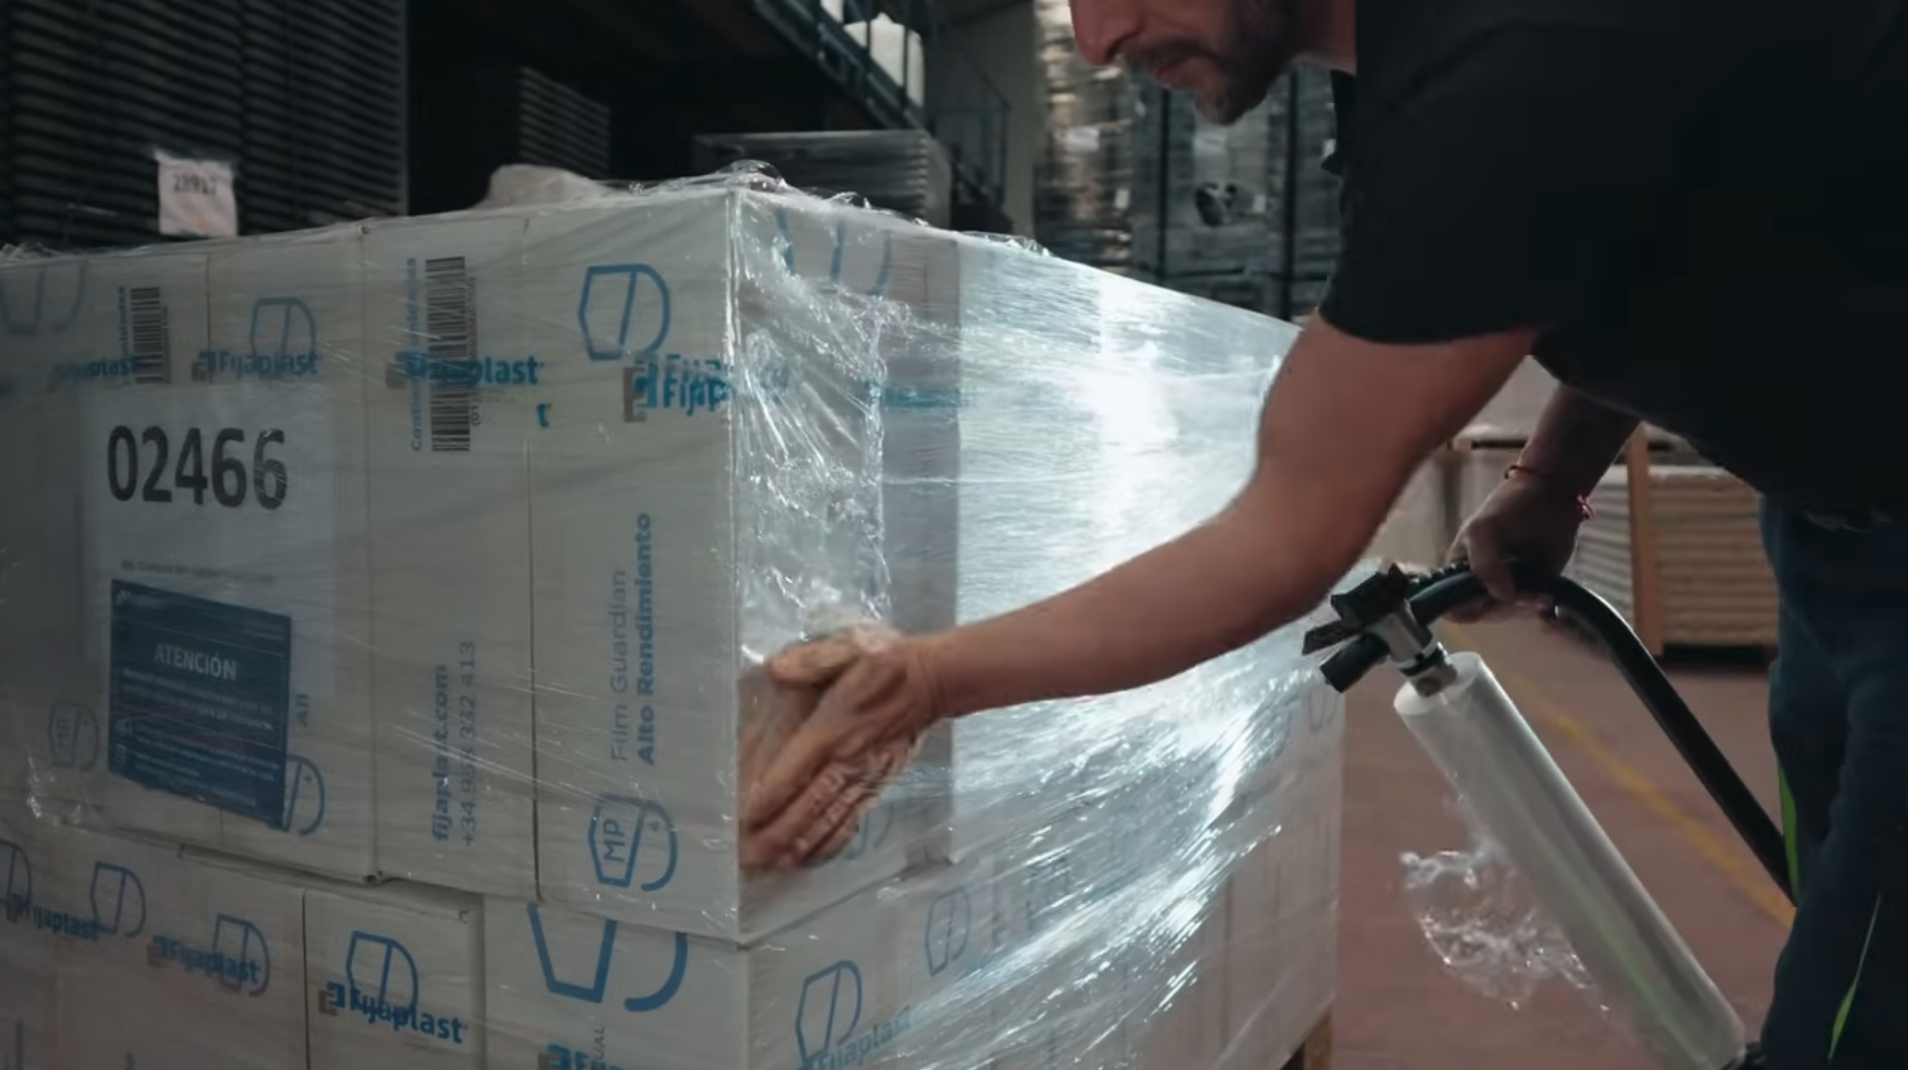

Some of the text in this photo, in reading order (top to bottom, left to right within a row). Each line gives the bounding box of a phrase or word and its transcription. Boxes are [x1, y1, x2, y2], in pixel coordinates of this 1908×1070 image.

[107, 425, 288, 510] 02466
[154, 642, 238, 682] ATENCIÓN
[459, 640, 476, 690] 413
[609, 569, 628, 762] Film Guardian
[634, 512, 656, 767] Alto Rendimiento
[459, 801, 476, 847] +34
[602, 817, 625, 862] MP
[349, 986, 463, 1045] Fijaplast
